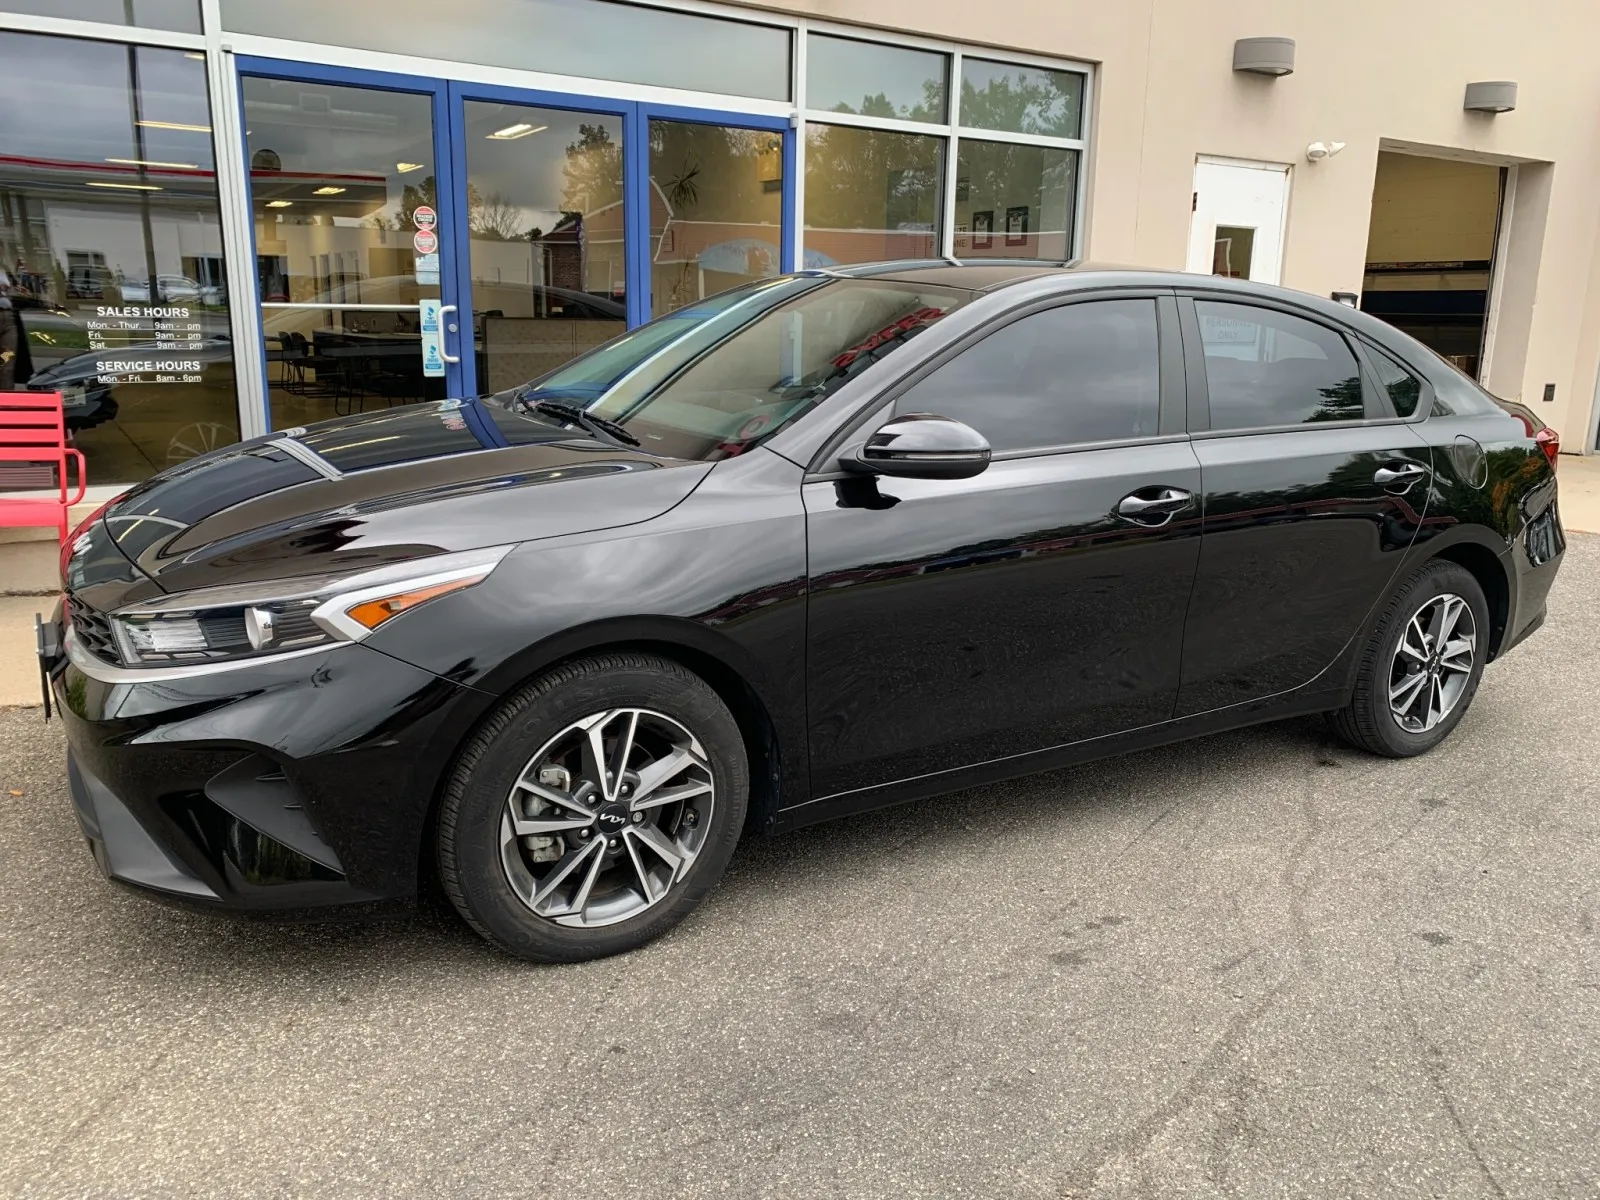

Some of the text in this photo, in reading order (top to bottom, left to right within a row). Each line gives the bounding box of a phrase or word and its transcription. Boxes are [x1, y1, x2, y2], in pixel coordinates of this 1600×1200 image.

[97, 306, 189, 318] SALES HOURS
[87, 321, 110, 329] Mon.
[119, 321, 141, 330] Thur.
[155, 322, 174, 330] 9am
[88, 331, 104, 340] Fri.
[155, 332, 174, 340] 9am
[90, 341, 108, 349] Sat.
[157, 341, 176, 350] 9am
[96, 361, 201, 371] SERVICE HOURS
[98, 375, 120, 383] Mon.
[128, 375, 143, 383] Fri.
[156, 374, 176, 382] 8am
[183, 374, 202, 382] 6pm
